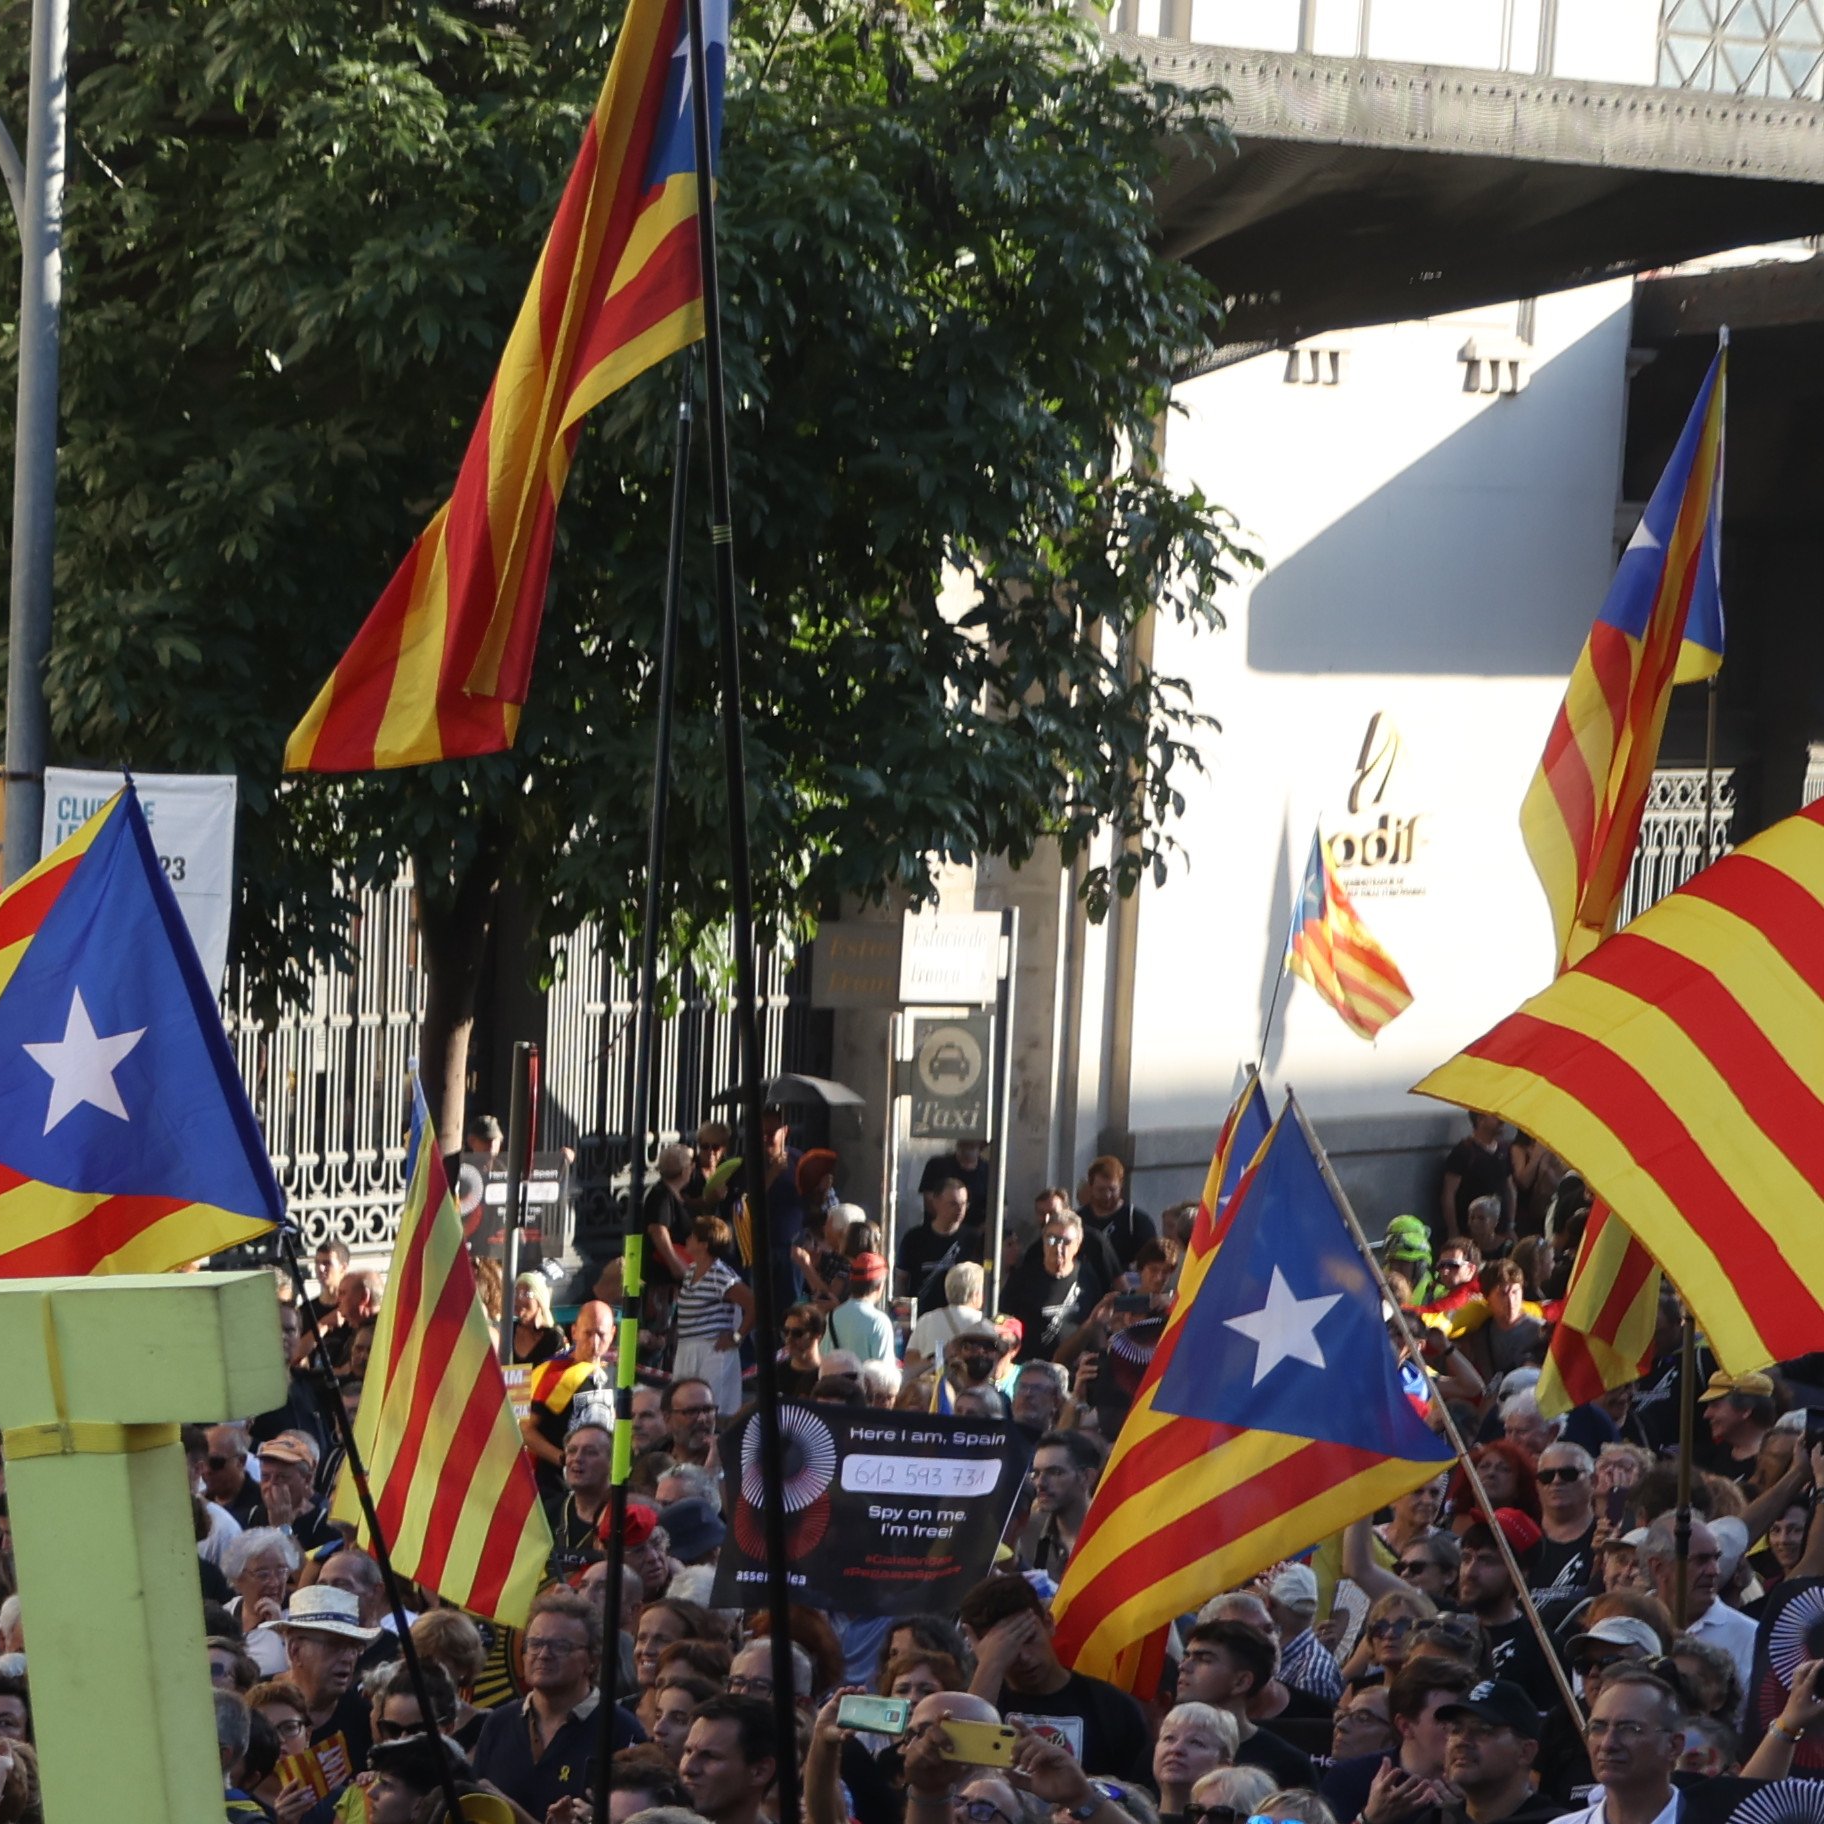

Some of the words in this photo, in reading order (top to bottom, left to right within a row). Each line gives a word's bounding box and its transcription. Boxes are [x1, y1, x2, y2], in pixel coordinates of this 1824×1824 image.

[58, 796, 105, 821] CLU
[919, 1099, 981, 1128] Taxi
[850, 1427, 896, 1442] Here
[902, 1427, 906, 1441] I
[911, 1432, 947, 1446] am,
[953, 1431, 1006, 1447] Spain
[869, 1505, 902, 1520] Spy
[908, 1508, 932, 1521] on
[881, 1522, 908, 1537] I'm
[913, 1523, 954, 1539] free!
[736, 1569, 806, 1585] asselea
